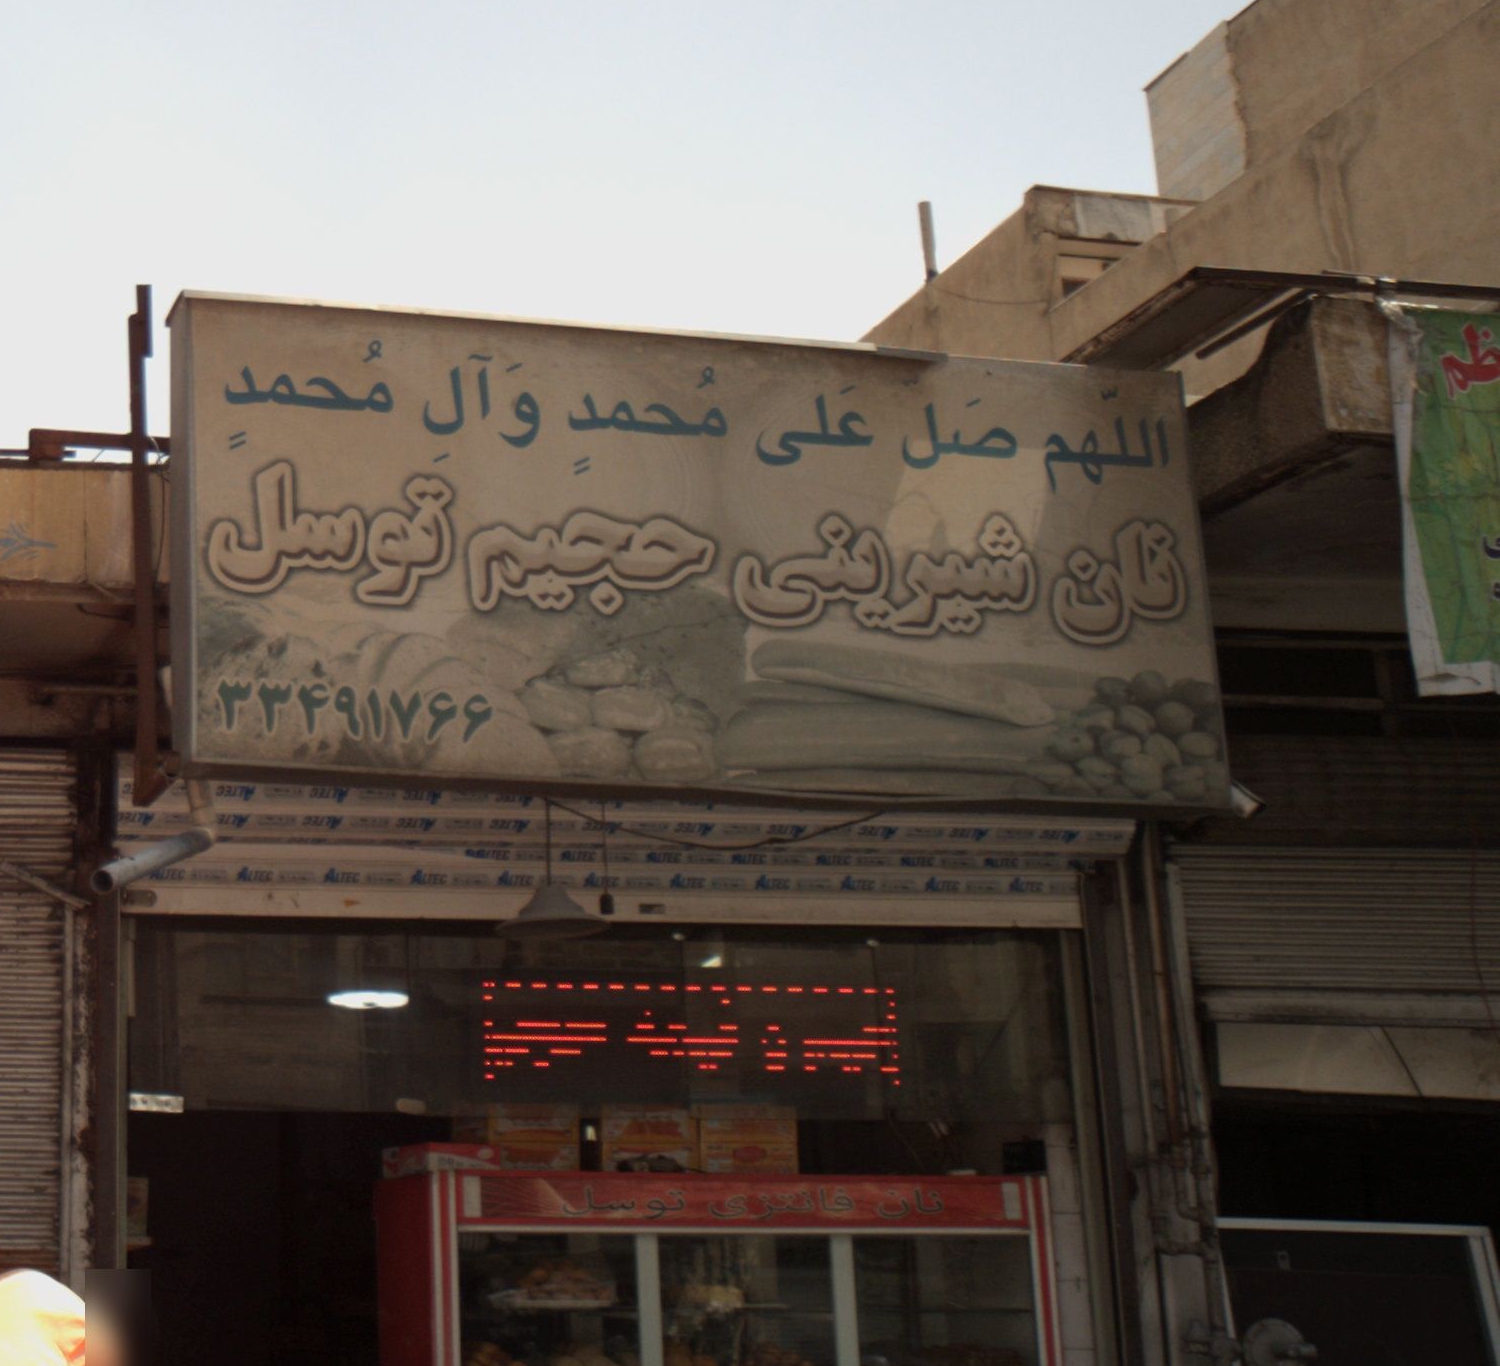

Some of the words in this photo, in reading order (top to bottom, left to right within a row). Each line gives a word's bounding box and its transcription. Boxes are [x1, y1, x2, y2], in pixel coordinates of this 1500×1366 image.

[208, 460, 453, 607] توسل
[463, 505, 716, 614] حجیم
[732, 513, 1038, 638] شیرینی
[1052, 519, 1187, 645] نان
[216, 678, 493, 744] ۳۳۴۹۱۷۶۶
[216, 813, 249, 828] ALTE
[877, 1188, 945, 1220] نان
